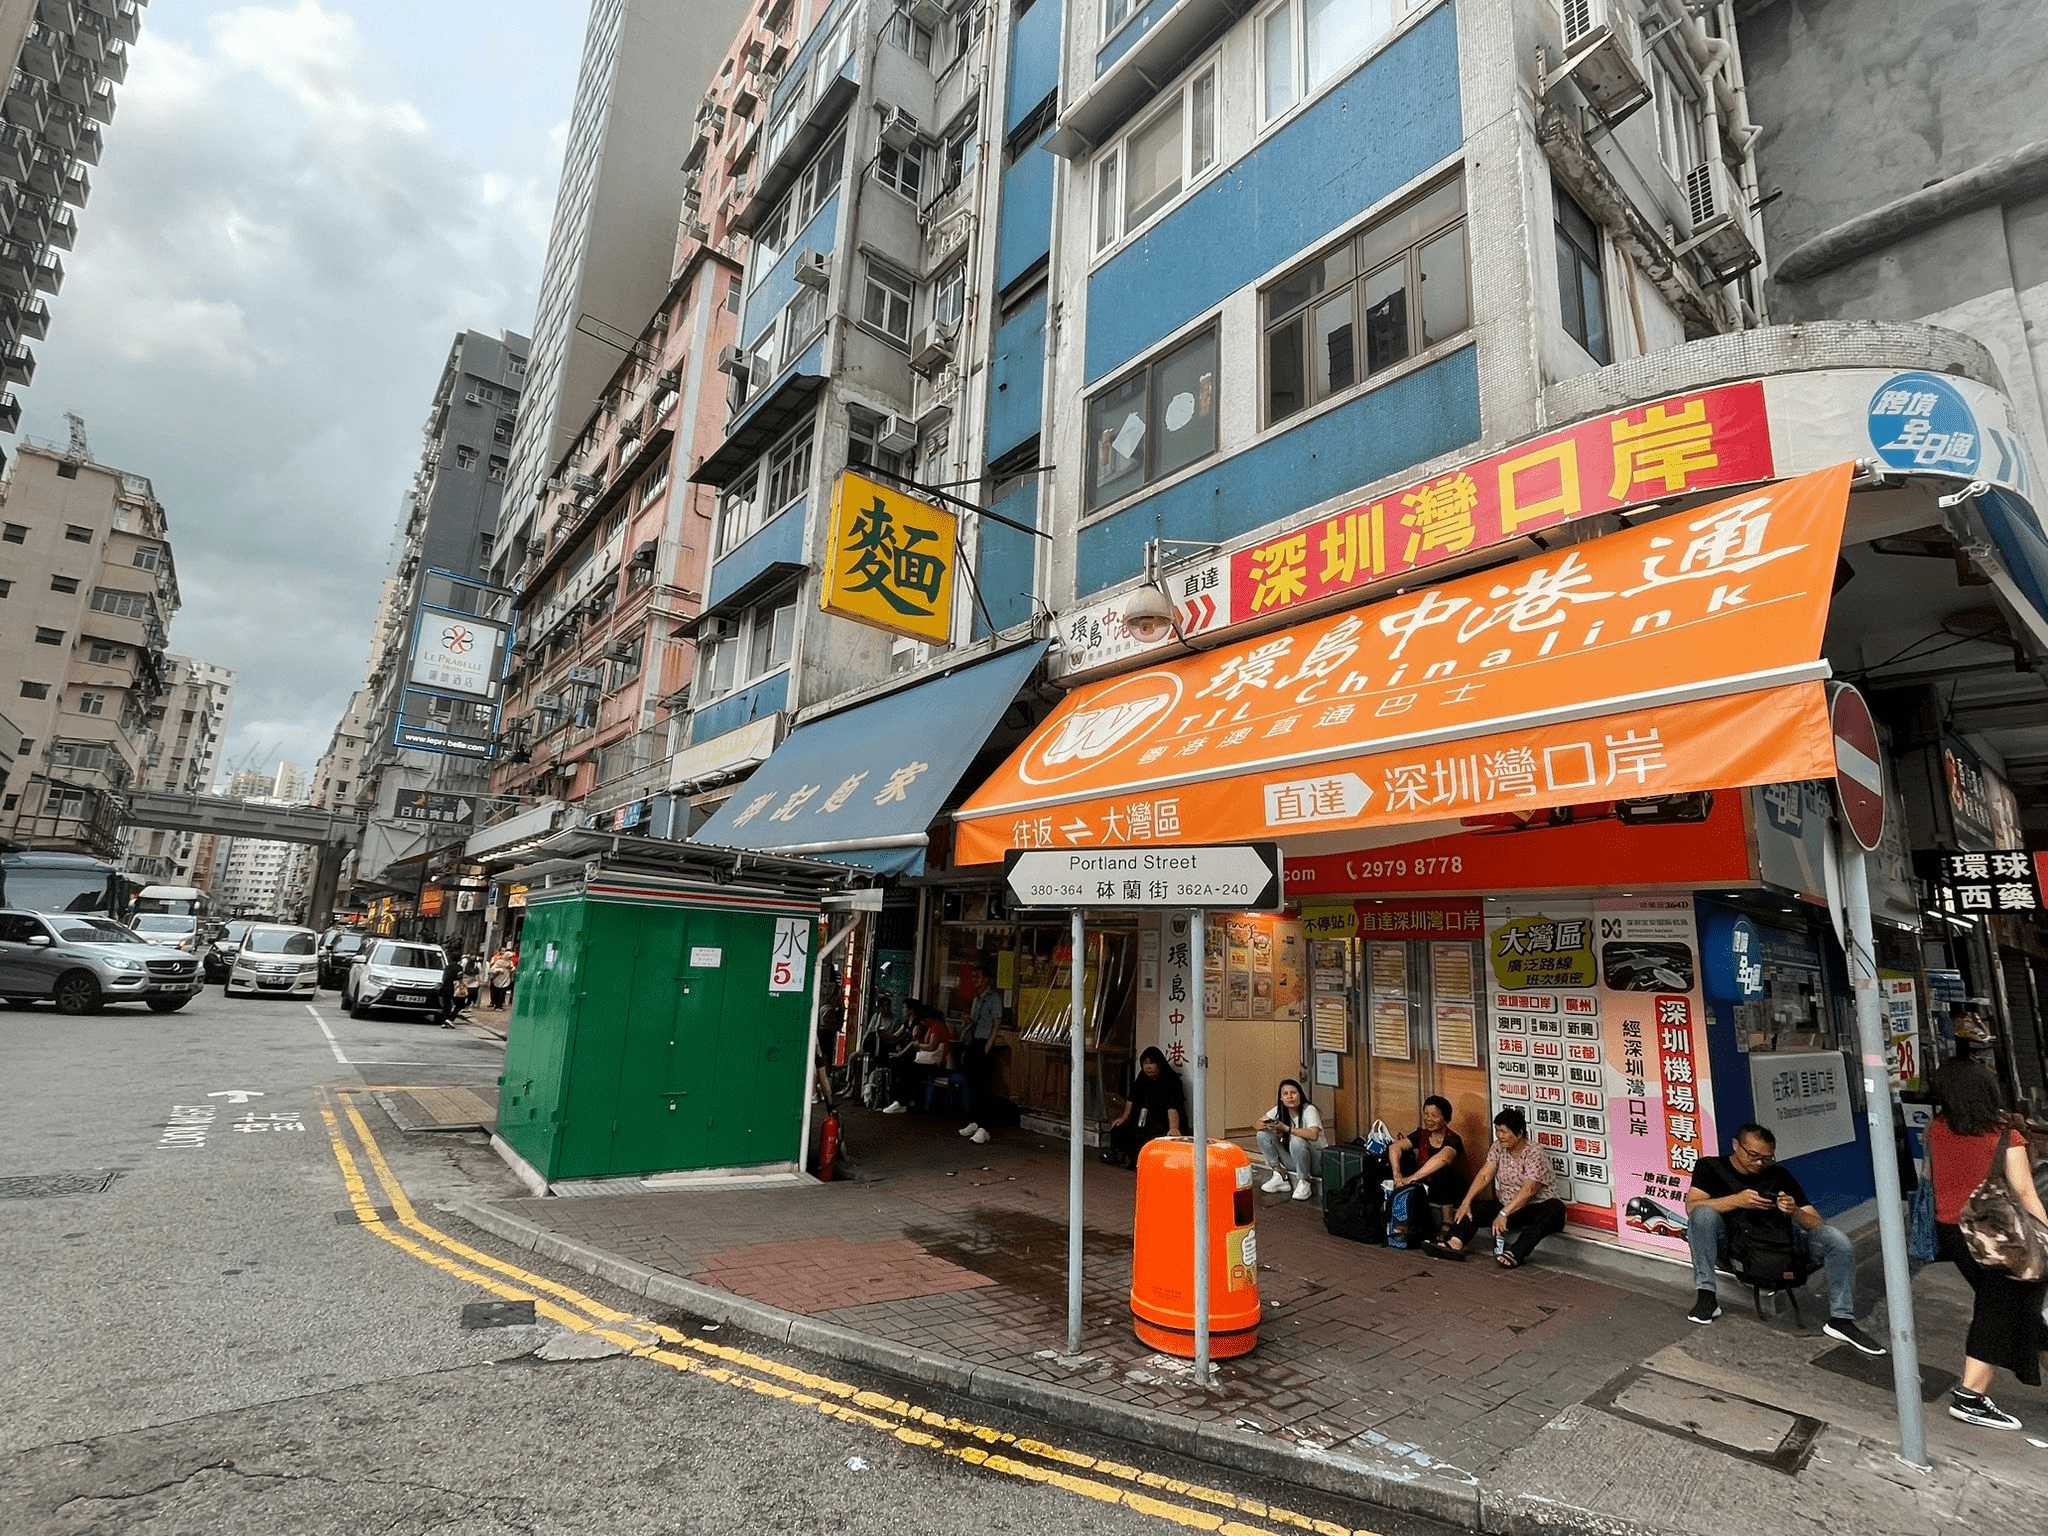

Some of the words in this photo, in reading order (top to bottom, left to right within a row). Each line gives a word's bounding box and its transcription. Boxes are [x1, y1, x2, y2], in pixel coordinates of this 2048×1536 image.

[1872, 391, 1939, 416] 跨境
[1879, 419, 1975, 466] 全日通
[1248, 399, 1718, 612] 深圳灣口岸
[842, 496, 946, 616] 麵
[1184, 567, 1219, 597] 直達
[1196, 497, 1810, 698] 環島中港通
[1176, 702, 1252, 735] TIL
[1295, 584, 1752, 704] Chinalink
[1137, 683, 1488, 765] 粵港澳直通巴士
[405, 734, 486, 752] www.leprbelle.com
[1383, 727, 1669, 814] 深圳灣口岸
[1273, 781, 1345, 822] 直達
[1012, 816, 1054, 848] 往返
[1100, 798, 1181, 844] 大灣區
[1070, 856, 1137, 871] Portland
[1144, 854, 1197, 870] Street
[1362, 860, 1406, 878] 2979
[1414, 856, 1462, 875] 8778
[1951, 852, 2031, 880] 環球
[1031, 884, 1083, 897] 380-364
[1096, 880, 1168, 900] 砵蘭街
[1177, 883, 1248, 896] 362A-240
[1956, 883, 2036, 910] 西藥
[1362, 910, 1480, 931] 直達深圳灣口岸
[774, 921, 807, 959] 水
[1500, 921, 1584, 956] 大灣區
[773, 962, 791, 985] 5
[1166, 943, 1190, 1067] 環島中港
[1534, 1042, 1557, 1055] 台山
[1535, 1063, 1558, 1077] 開平
[1623, 1020, 1648, 1136] 經深圳灣口岸
[1536, 1087, 1560, 1101] 江門
[1660, 1000, 1698, 1172] 深圳機場專線
[156, 1125, 209, 1150] LOOK
[1576, 1162, 1603, 1179] 東莞
